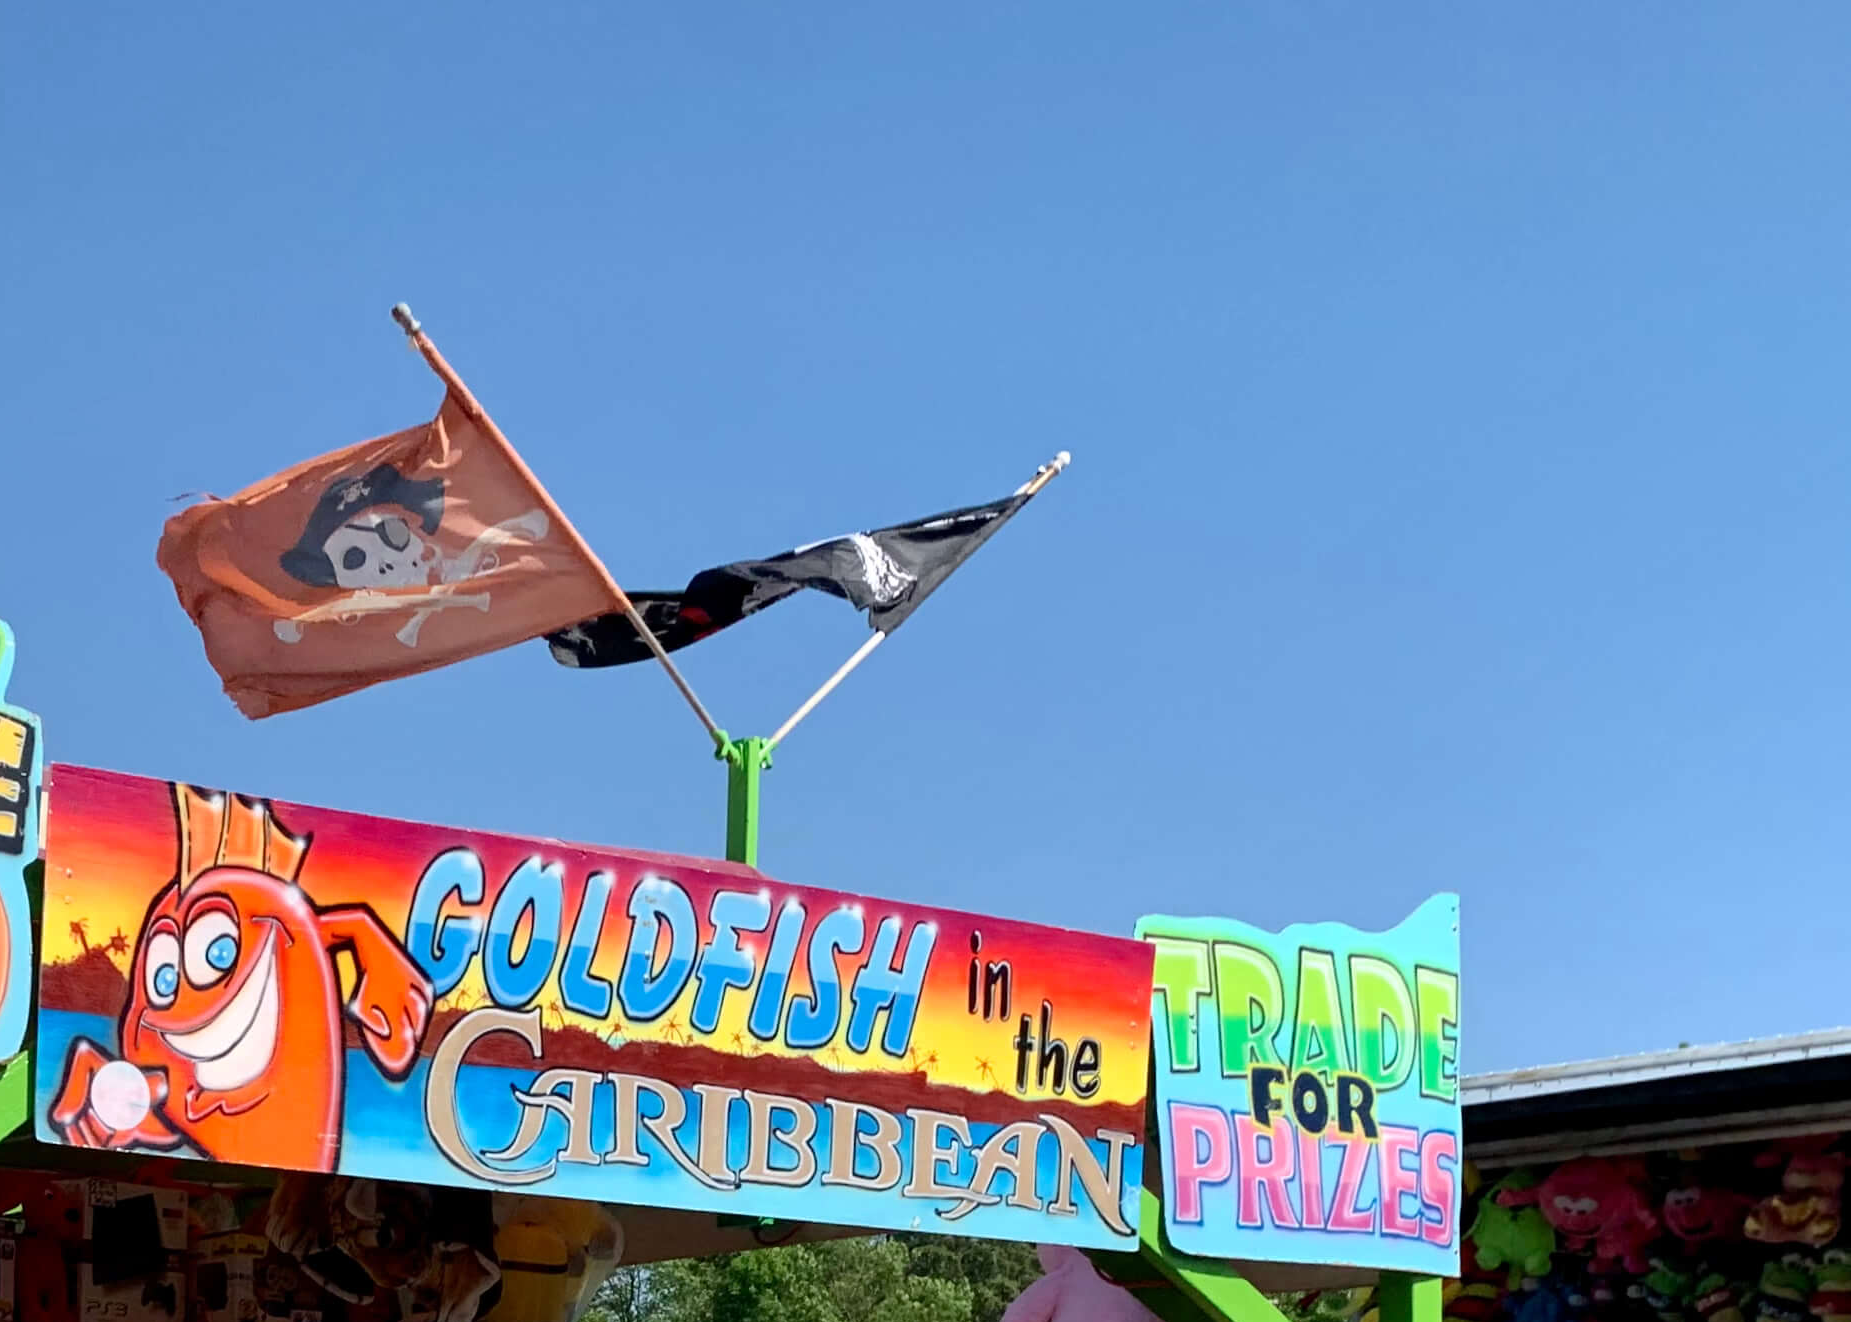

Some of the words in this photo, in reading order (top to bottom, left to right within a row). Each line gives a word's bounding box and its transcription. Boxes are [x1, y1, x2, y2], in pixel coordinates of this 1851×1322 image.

[405, 846, 939, 1058] GOLDFISH
[967, 929, 1013, 1022] in
[1143, 934, 1458, 1105] TRADE
[425, 1005, 1137, 1237] CARIBBEAN
[1012, 1000, 1102, 1098] the
[1248, 1062, 1380, 1140] FOR
[1167, 1100, 1458, 1249] PRIZES
